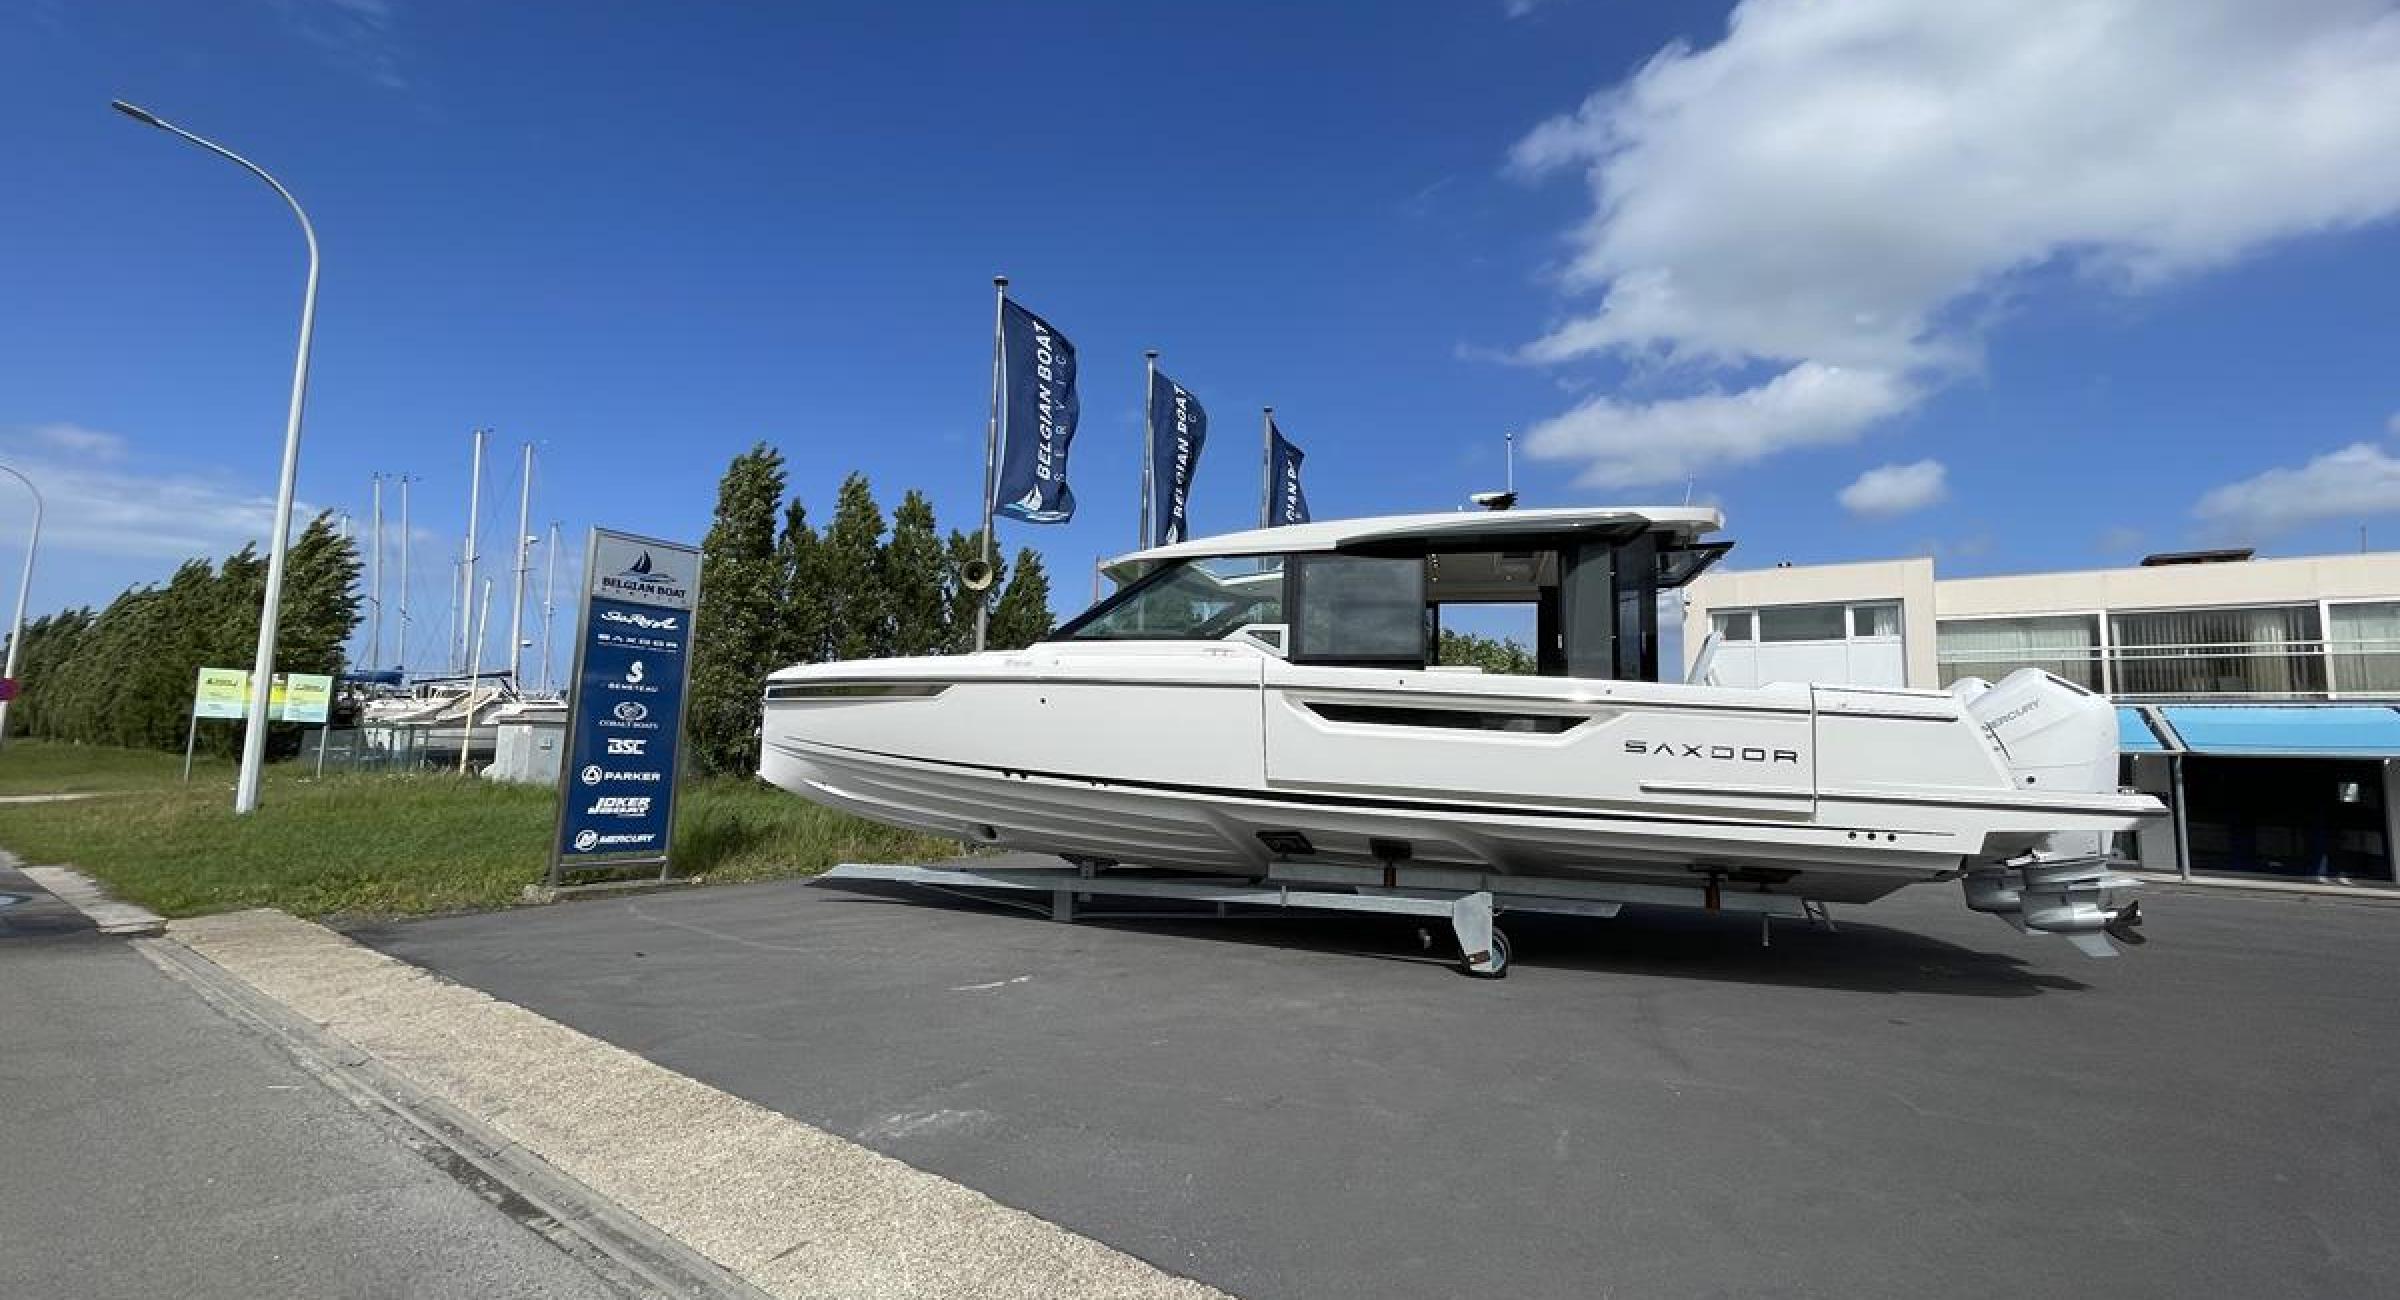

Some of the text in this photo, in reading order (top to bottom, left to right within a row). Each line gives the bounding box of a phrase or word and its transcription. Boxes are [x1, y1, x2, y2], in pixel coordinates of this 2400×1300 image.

[1032, 320, 1053, 481] BELGIAN BOAT
[1053, 355, 1067, 483] SERVIC
[1173, 383, 1188, 435] BOAT
[602, 577, 655, 595] BELGIAN
[657, 586, 687, 599] BOAT
[1624, 739, 1799, 765] SAXDOR
[603, 771, 661, 781] PARKER
